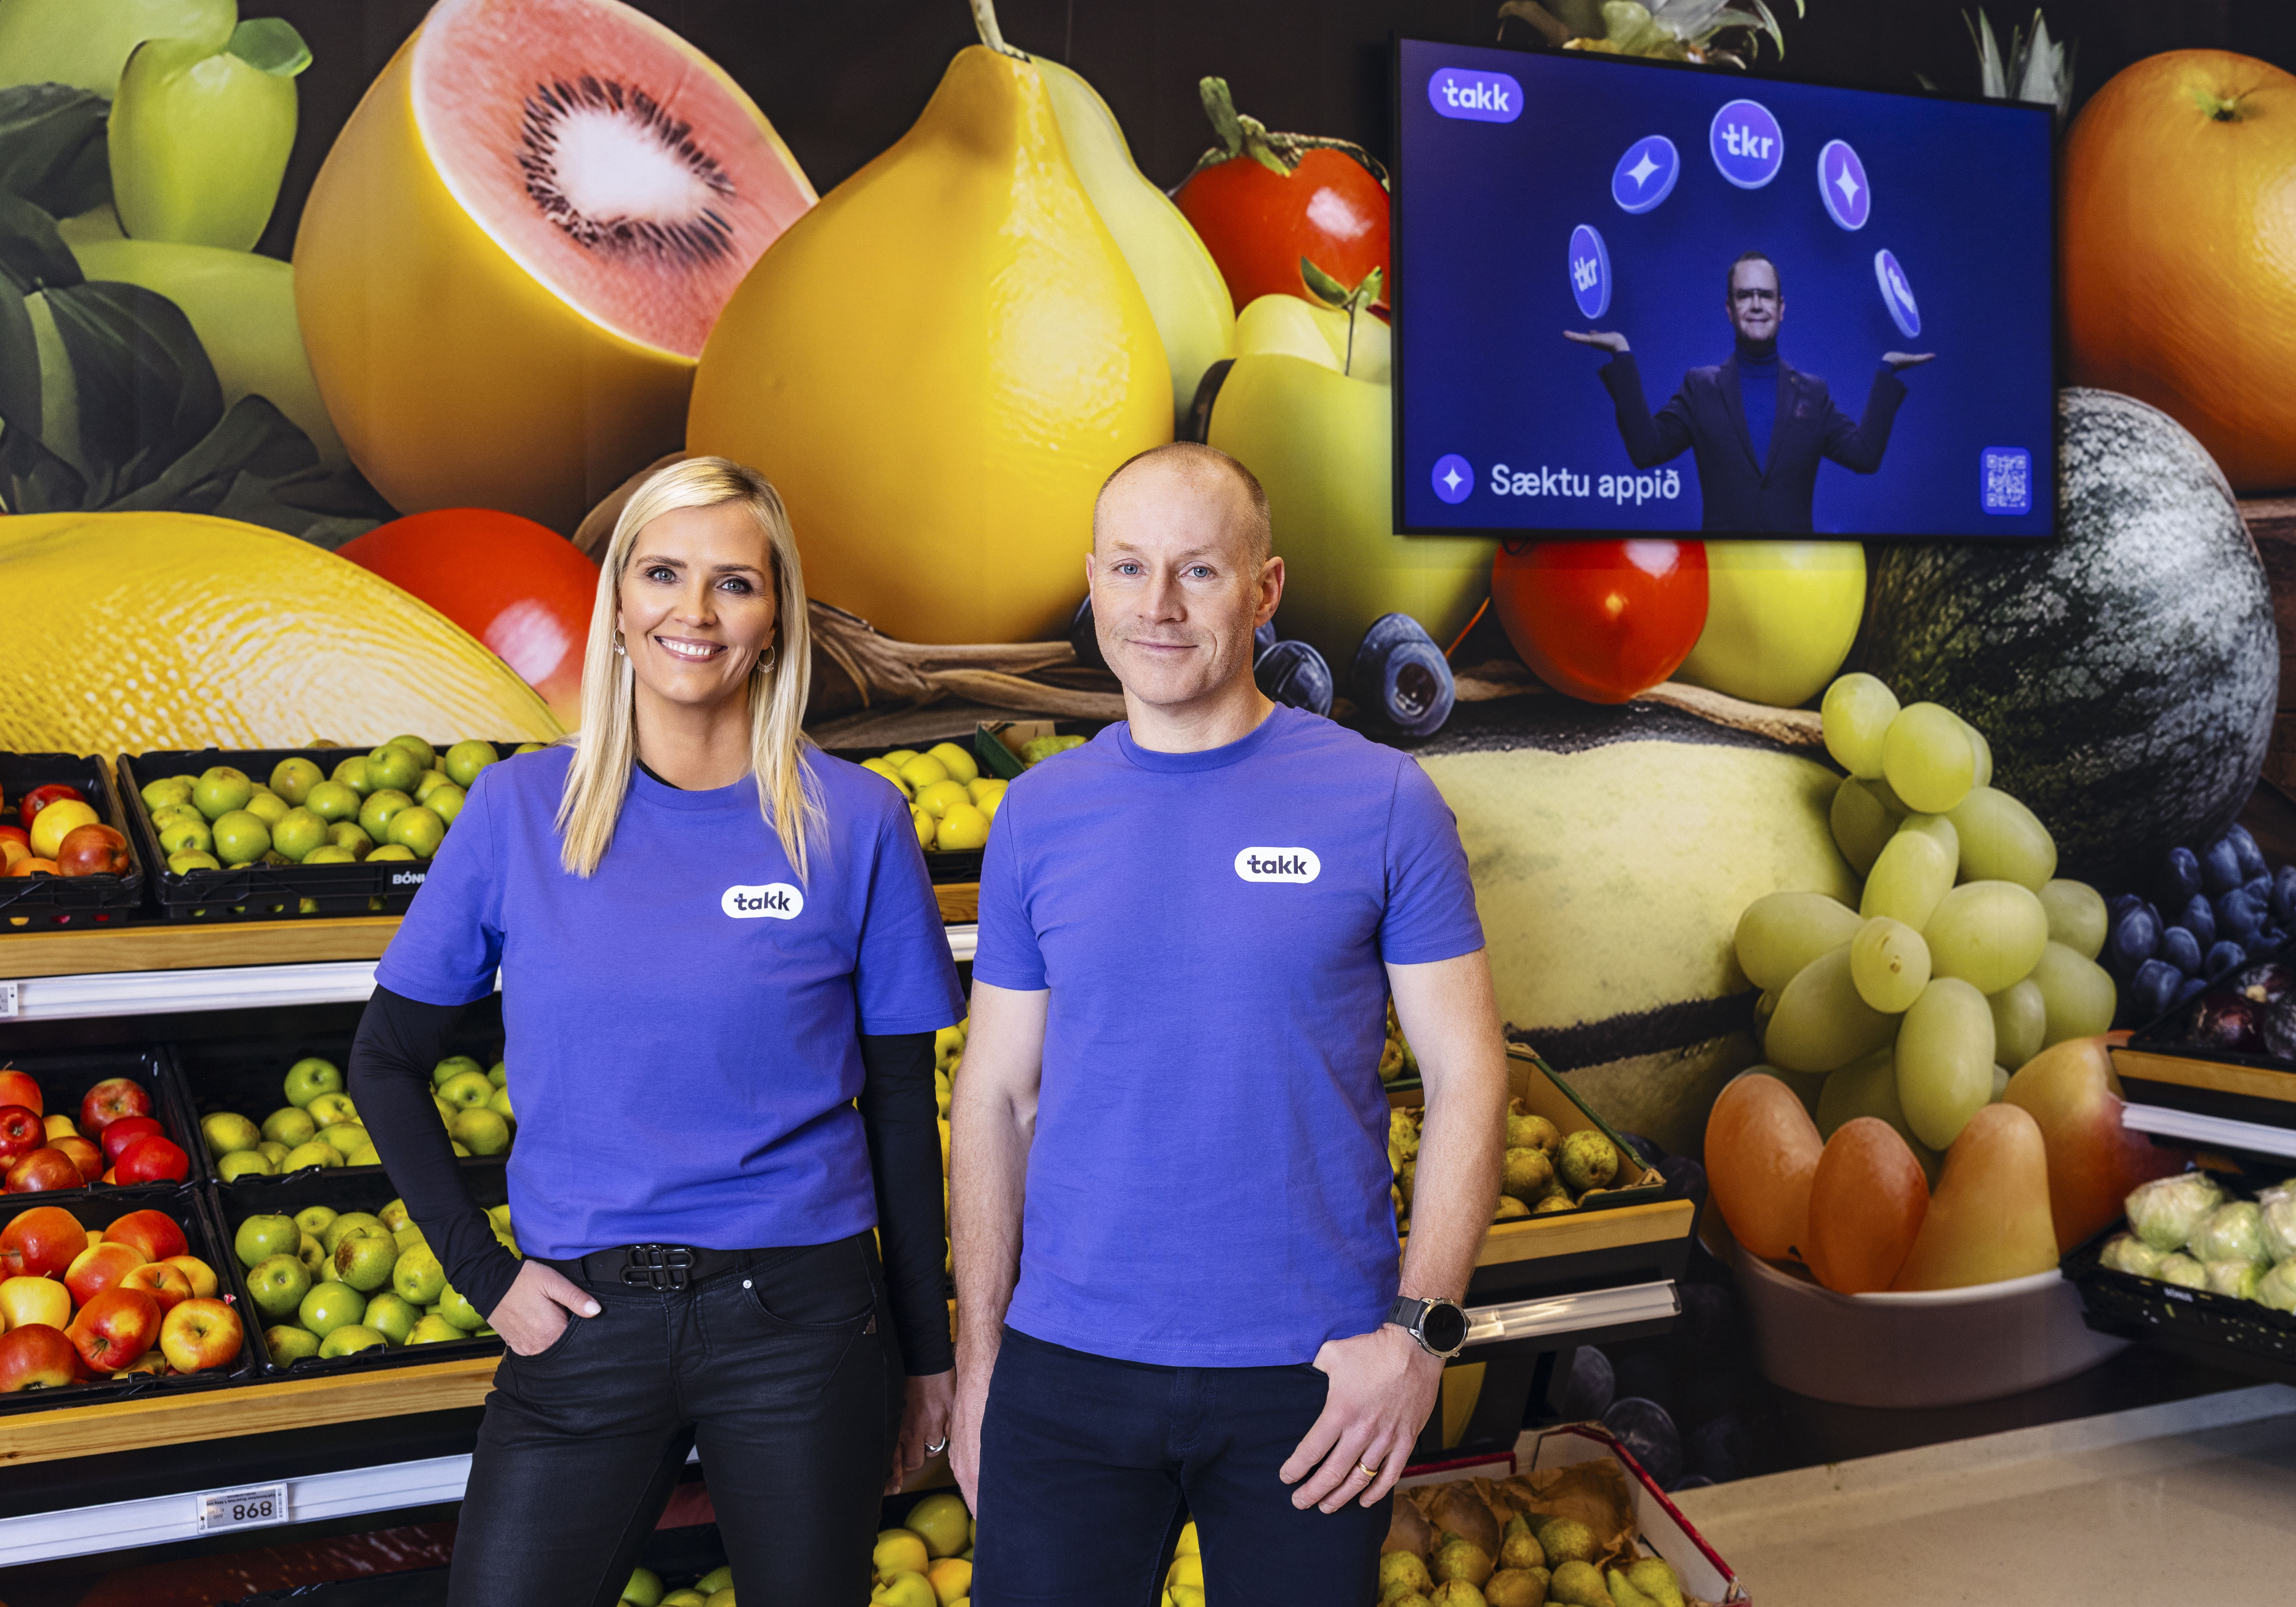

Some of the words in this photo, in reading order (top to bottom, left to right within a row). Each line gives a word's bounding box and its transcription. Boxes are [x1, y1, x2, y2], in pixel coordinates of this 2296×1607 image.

[1442, 79, 1509, 112] takk
[1721, 123, 1773, 159] tkr
[1491, 463, 1590, 497] Sæktu
[1598, 469, 1681, 506] appið
[1247, 854, 1307, 875] takk
[734, 891, 791, 911] takk
[233, 1501, 272, 1520] 898
